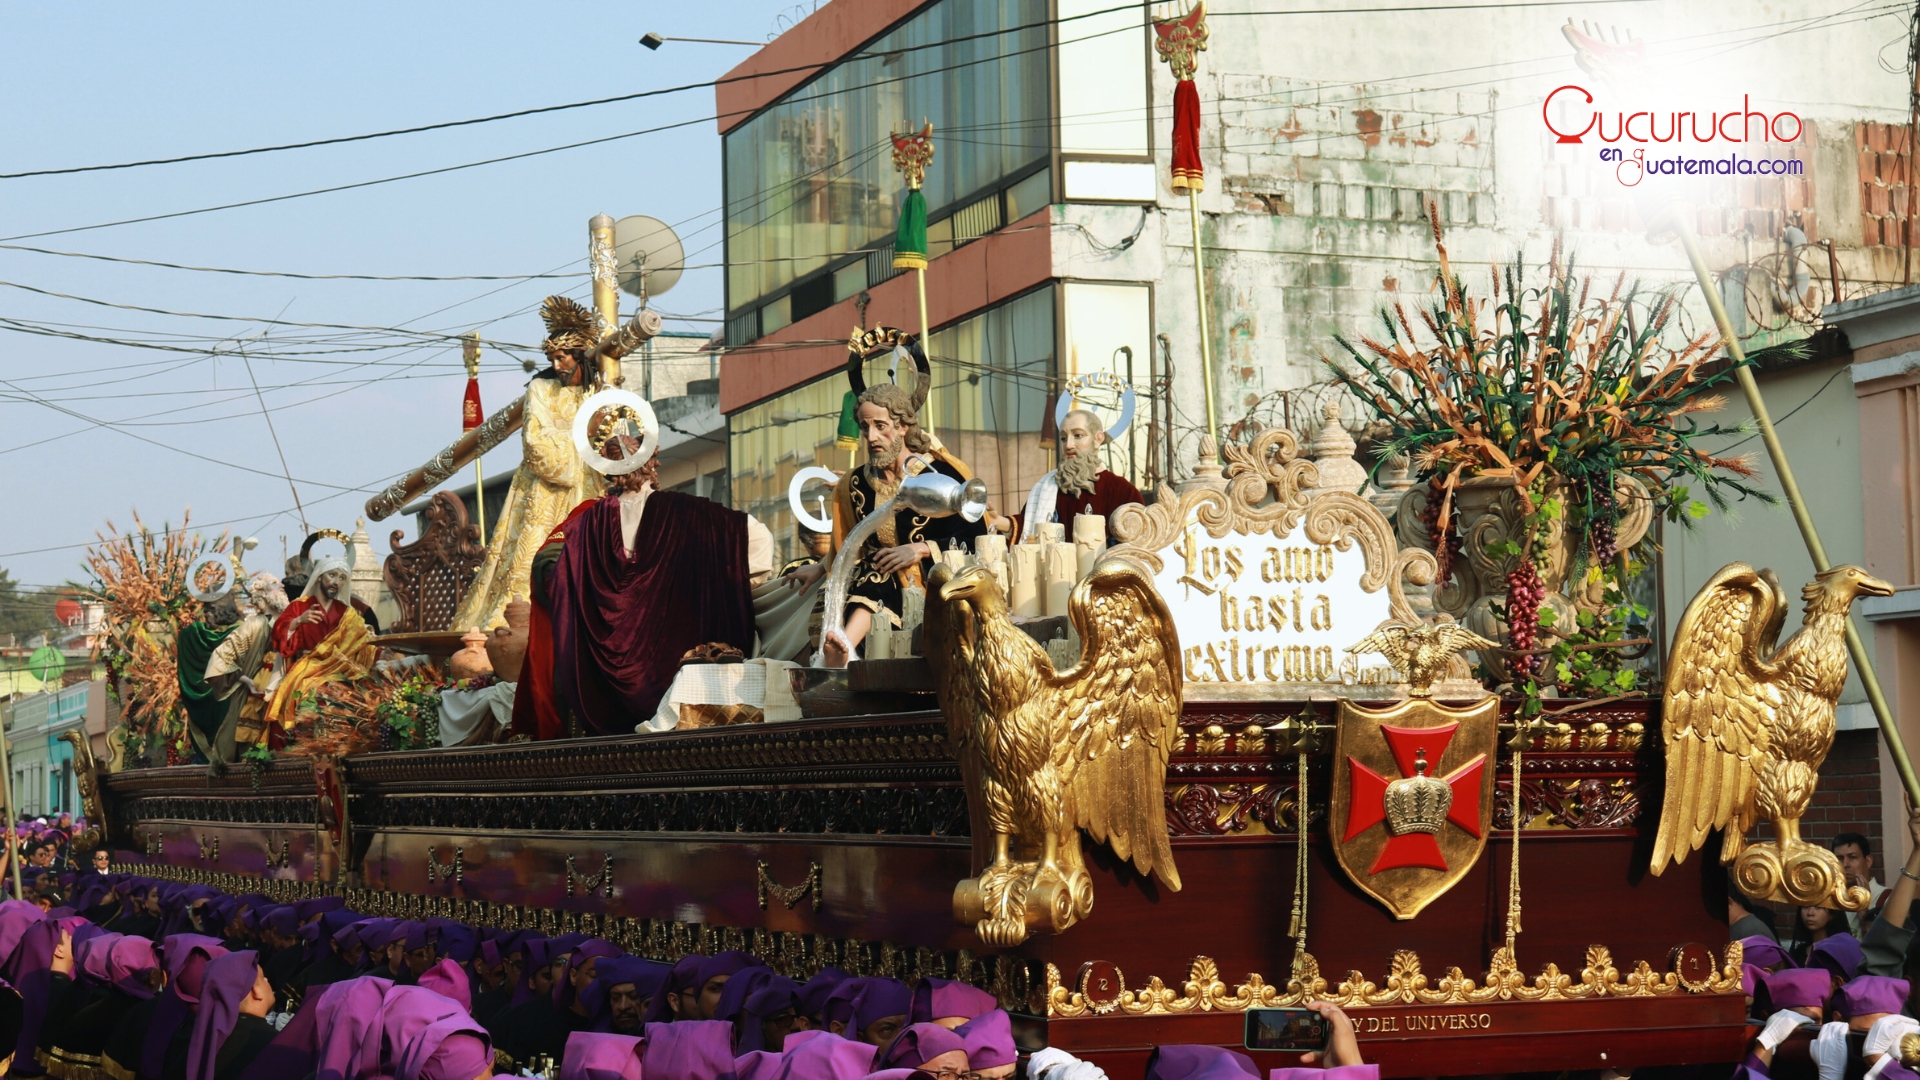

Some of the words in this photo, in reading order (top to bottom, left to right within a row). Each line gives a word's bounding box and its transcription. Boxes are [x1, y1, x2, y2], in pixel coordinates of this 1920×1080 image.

[1174, 516, 1245, 601] Los
[1260, 543, 1335, 583] amo
[1219, 587, 1335, 633] hasta
[1184, 635, 1336, 683] extremo
[1366, 1016, 1400, 1032] DEL
[1404, 1013, 1491, 1031] UNIVERSO
